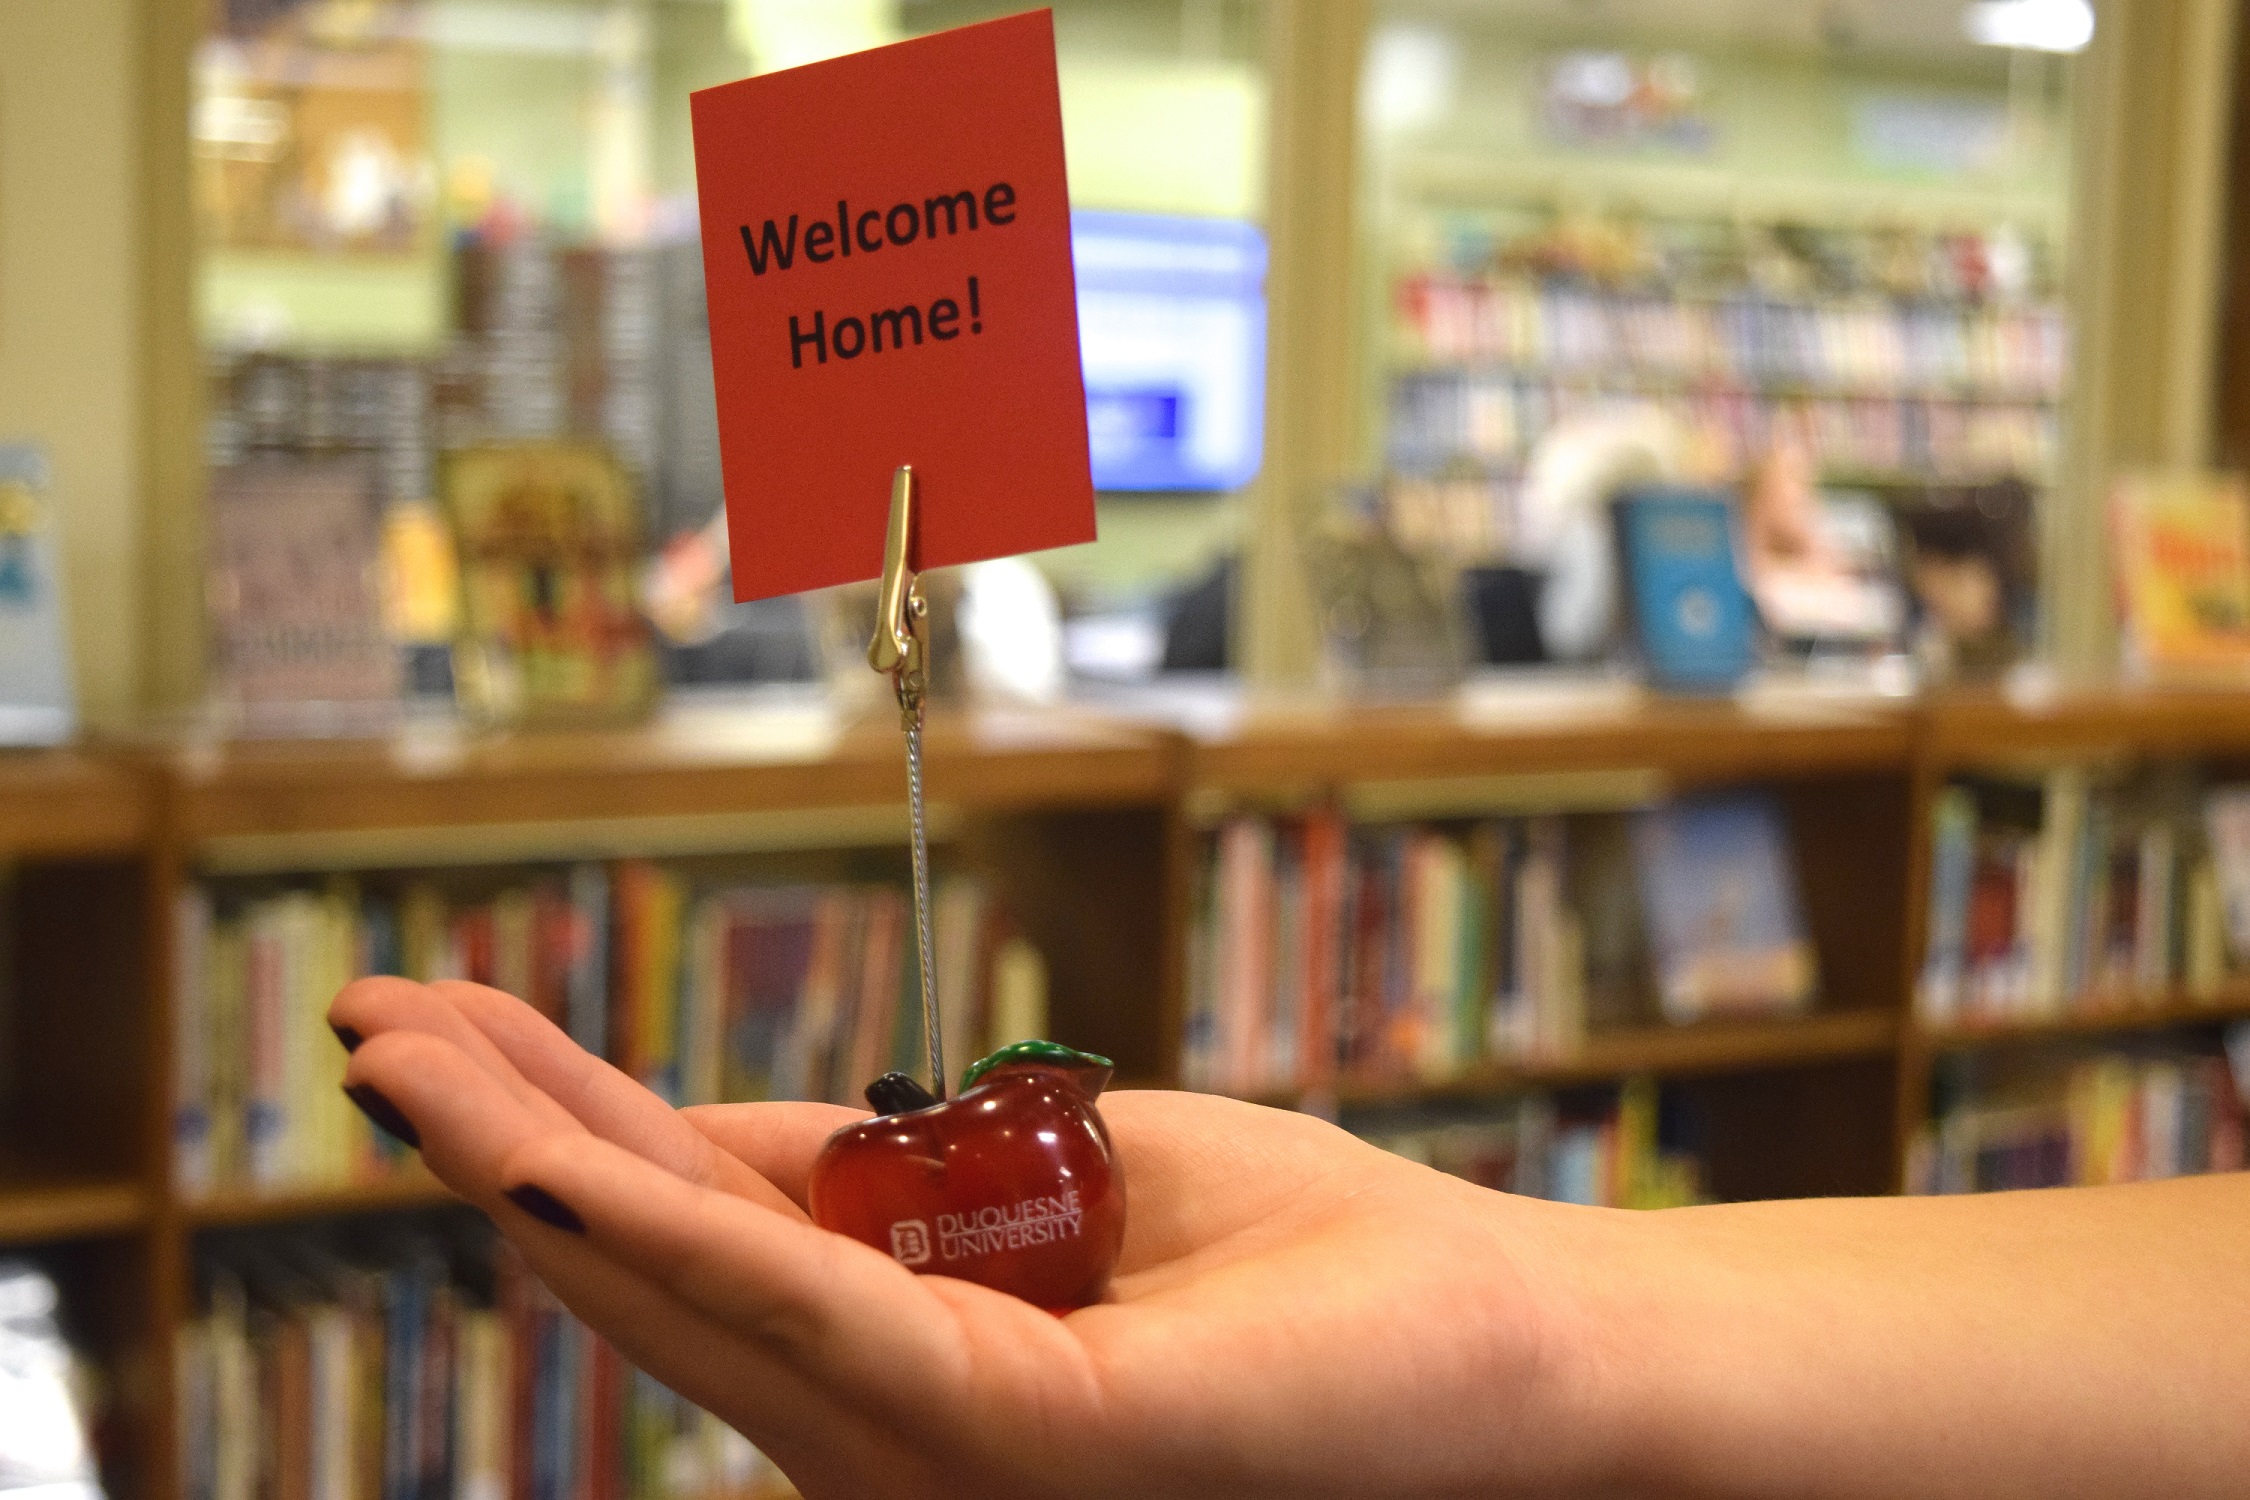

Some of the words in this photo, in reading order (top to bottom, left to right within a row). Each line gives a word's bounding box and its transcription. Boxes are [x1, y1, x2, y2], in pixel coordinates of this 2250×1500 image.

[740, 181, 1016, 277] Welcome
[788, 276, 983, 369] Home!
[937, 1190, 1080, 1235] DUQUESNE
[940, 1212, 1082, 1260] UNIVERSITY
